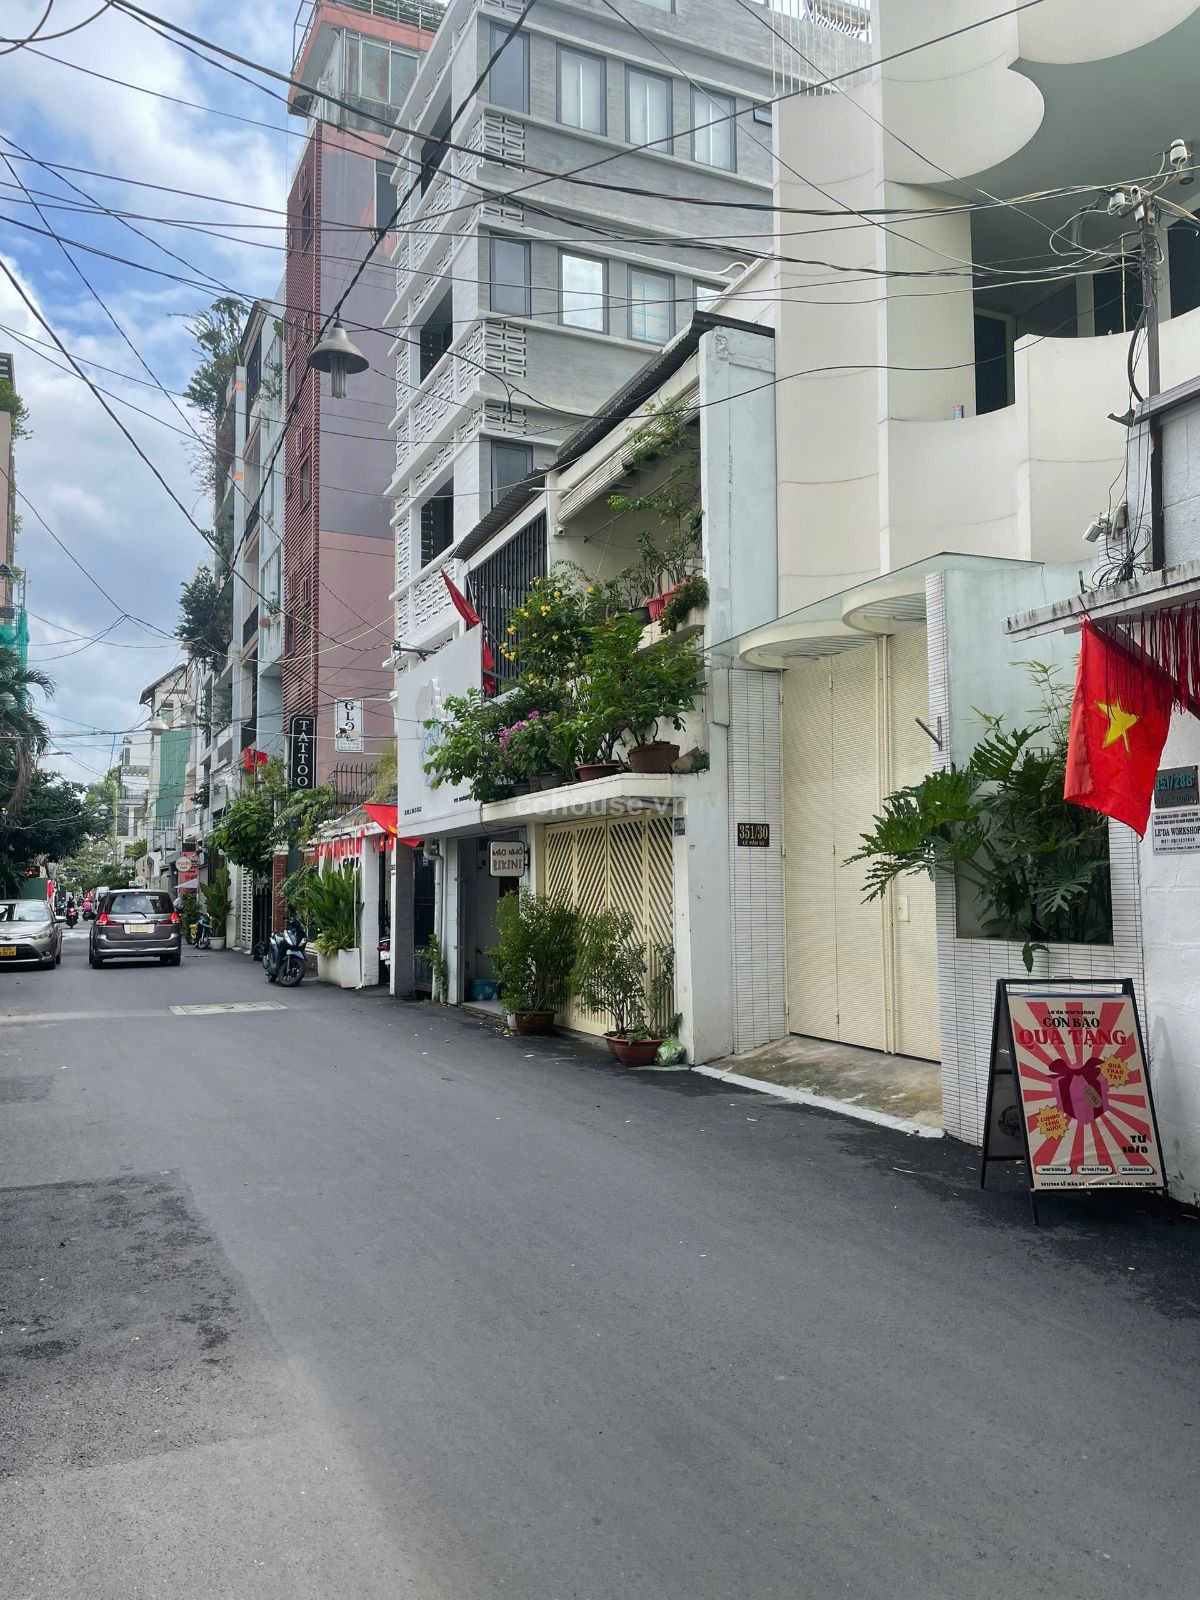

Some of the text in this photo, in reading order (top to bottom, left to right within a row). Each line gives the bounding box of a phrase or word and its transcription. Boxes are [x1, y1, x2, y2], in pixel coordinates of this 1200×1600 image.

[297, 720, 309, 787] TATTOO
[739, 824, 768, 839] 351/30
[1154, 828, 1170, 837] LE'DA
[493, 858, 522, 872] BIKINI
[1040, 1113, 1060, 1123] COMBO
